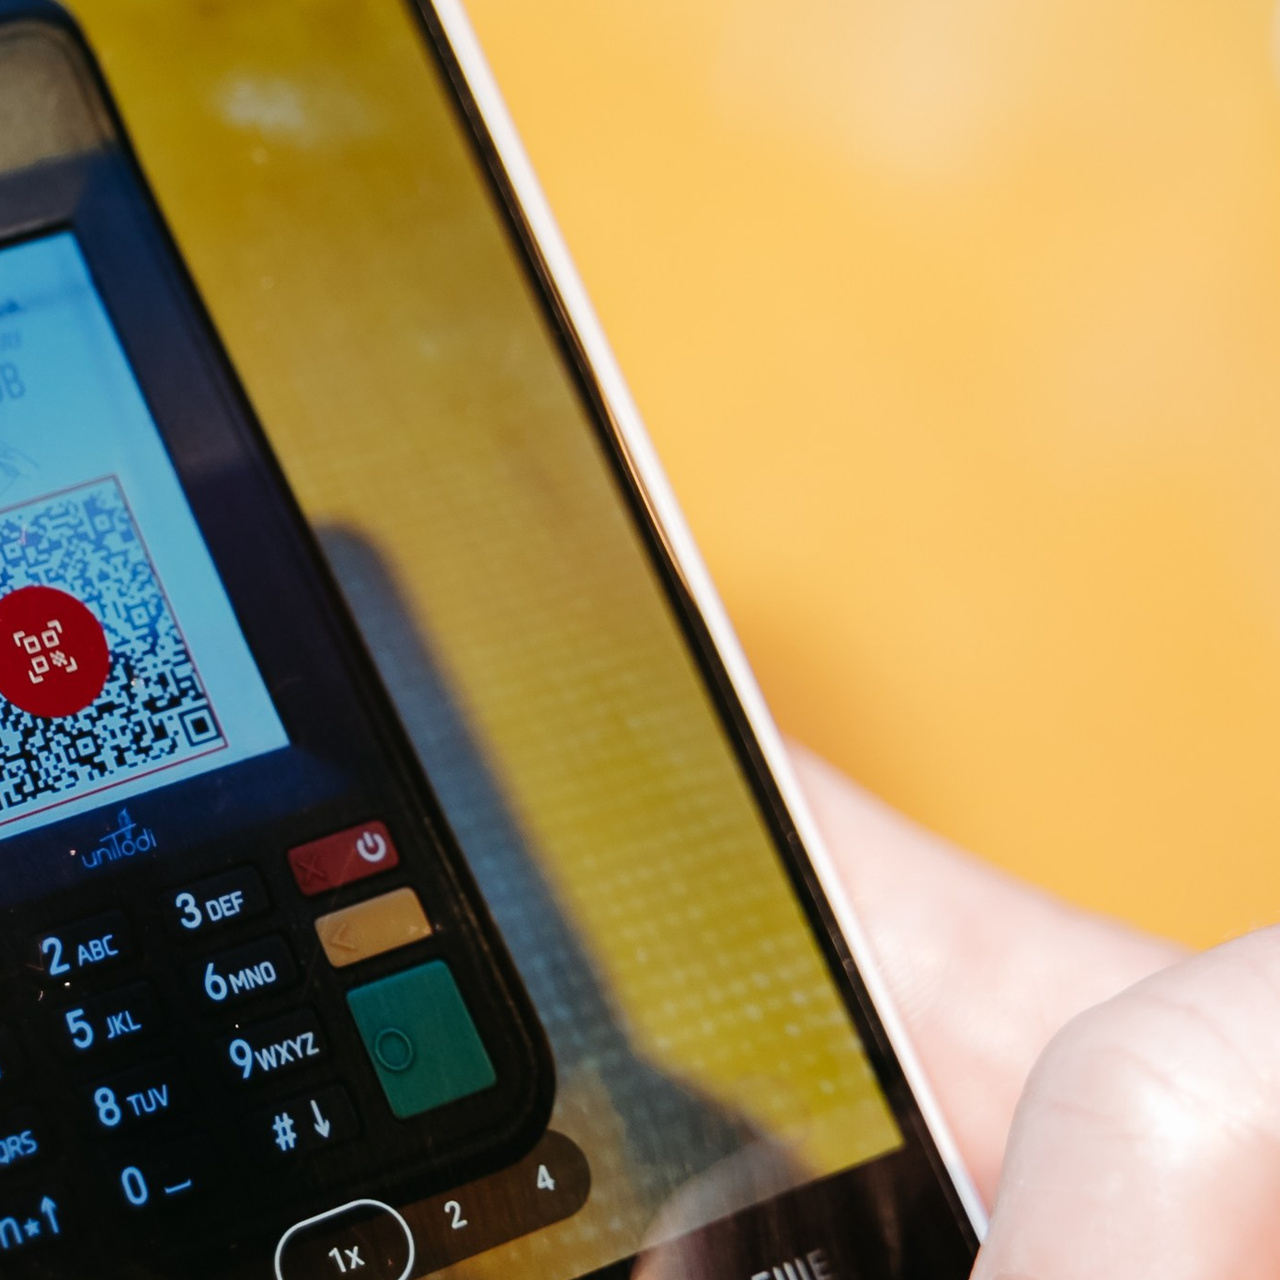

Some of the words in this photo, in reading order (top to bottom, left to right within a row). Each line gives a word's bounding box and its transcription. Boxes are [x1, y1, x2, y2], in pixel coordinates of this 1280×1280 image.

[175, 893, 202, 929] 3
[205, 891, 244, 922] DEF
[41, 936, 70, 976] 2
[77, 934, 119, 967] ABC
[204, 962, 229, 1001] 6
[228, 961, 277, 995] MNO
[65, 1008, 94, 1049] 5
[106, 1010, 142, 1039] JKL
[229, 1038, 253, 1079] 9
[253, 1031, 320, 1072] WXYZ
[93, 1086, 122, 1127] 8
[126, 1084, 169, 1117] TUV
[121, 1166, 149, 1206] 0
[328, 1245, 366, 1273] 1x
[444, 1200, 469, 1230] 2
[536, 1164, 556, 1192] 4
